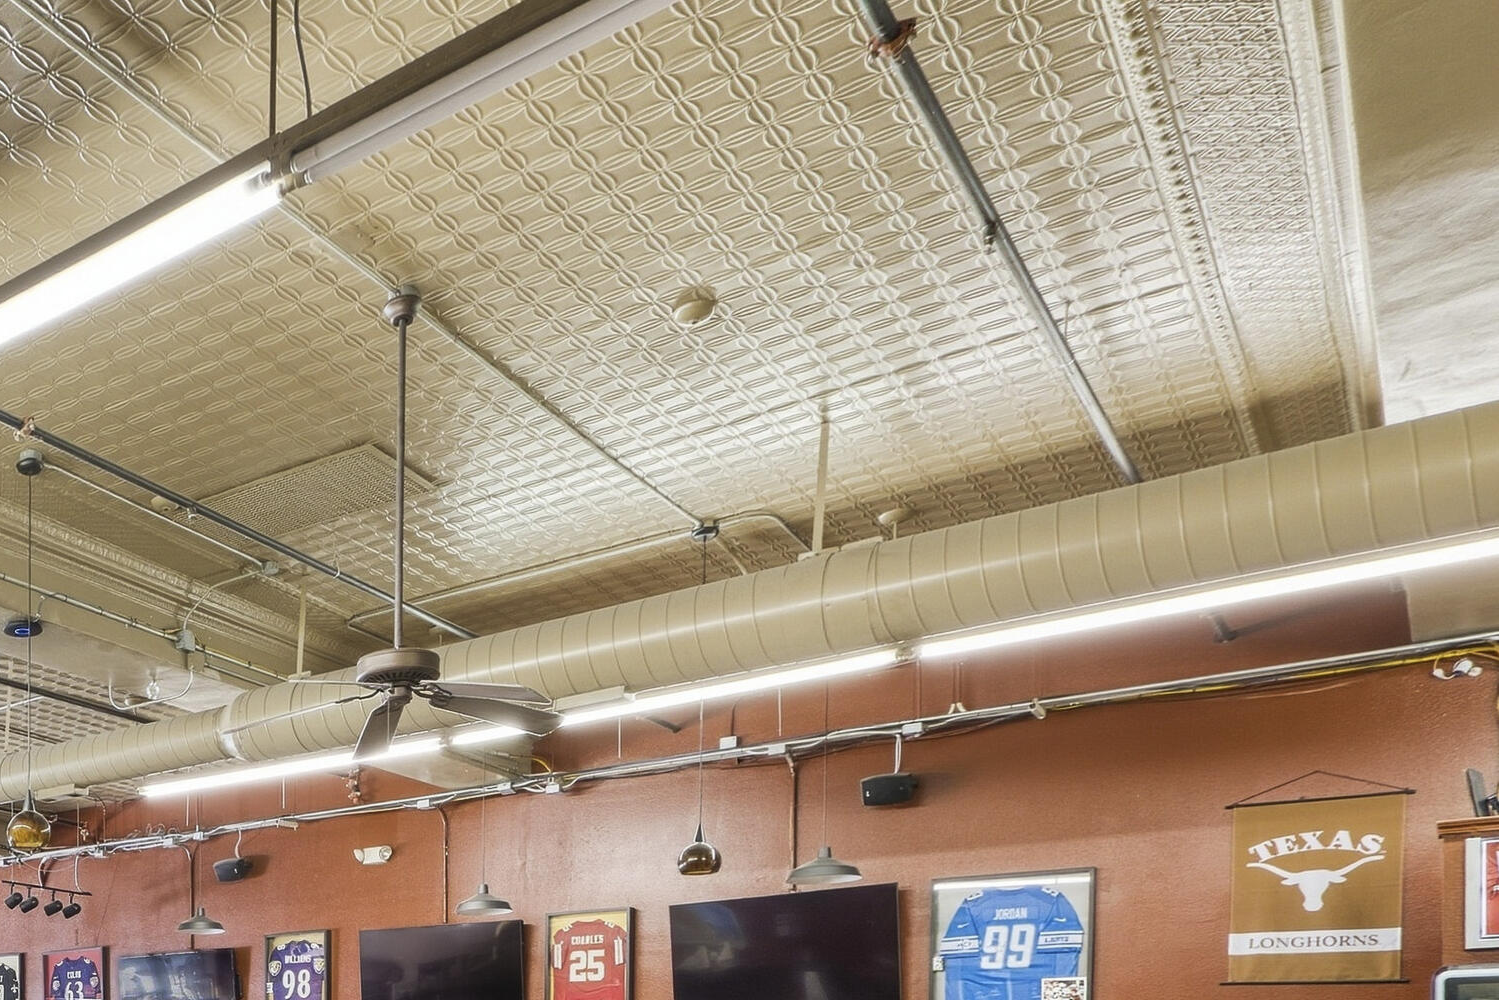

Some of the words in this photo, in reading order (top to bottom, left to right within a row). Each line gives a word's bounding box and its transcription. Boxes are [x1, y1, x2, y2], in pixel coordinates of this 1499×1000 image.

[1248, 830, 1385, 863] TEXAS
[993, 906, 1028, 920] JORDAN
[571, 934, 604, 945] CHARLES
[980, 923, 1036, 970] 99
[1249, 934, 1379, 949] LONGHORNS
[569, 949, 605, 982] 25
[282, 969, 311, 999] 98
